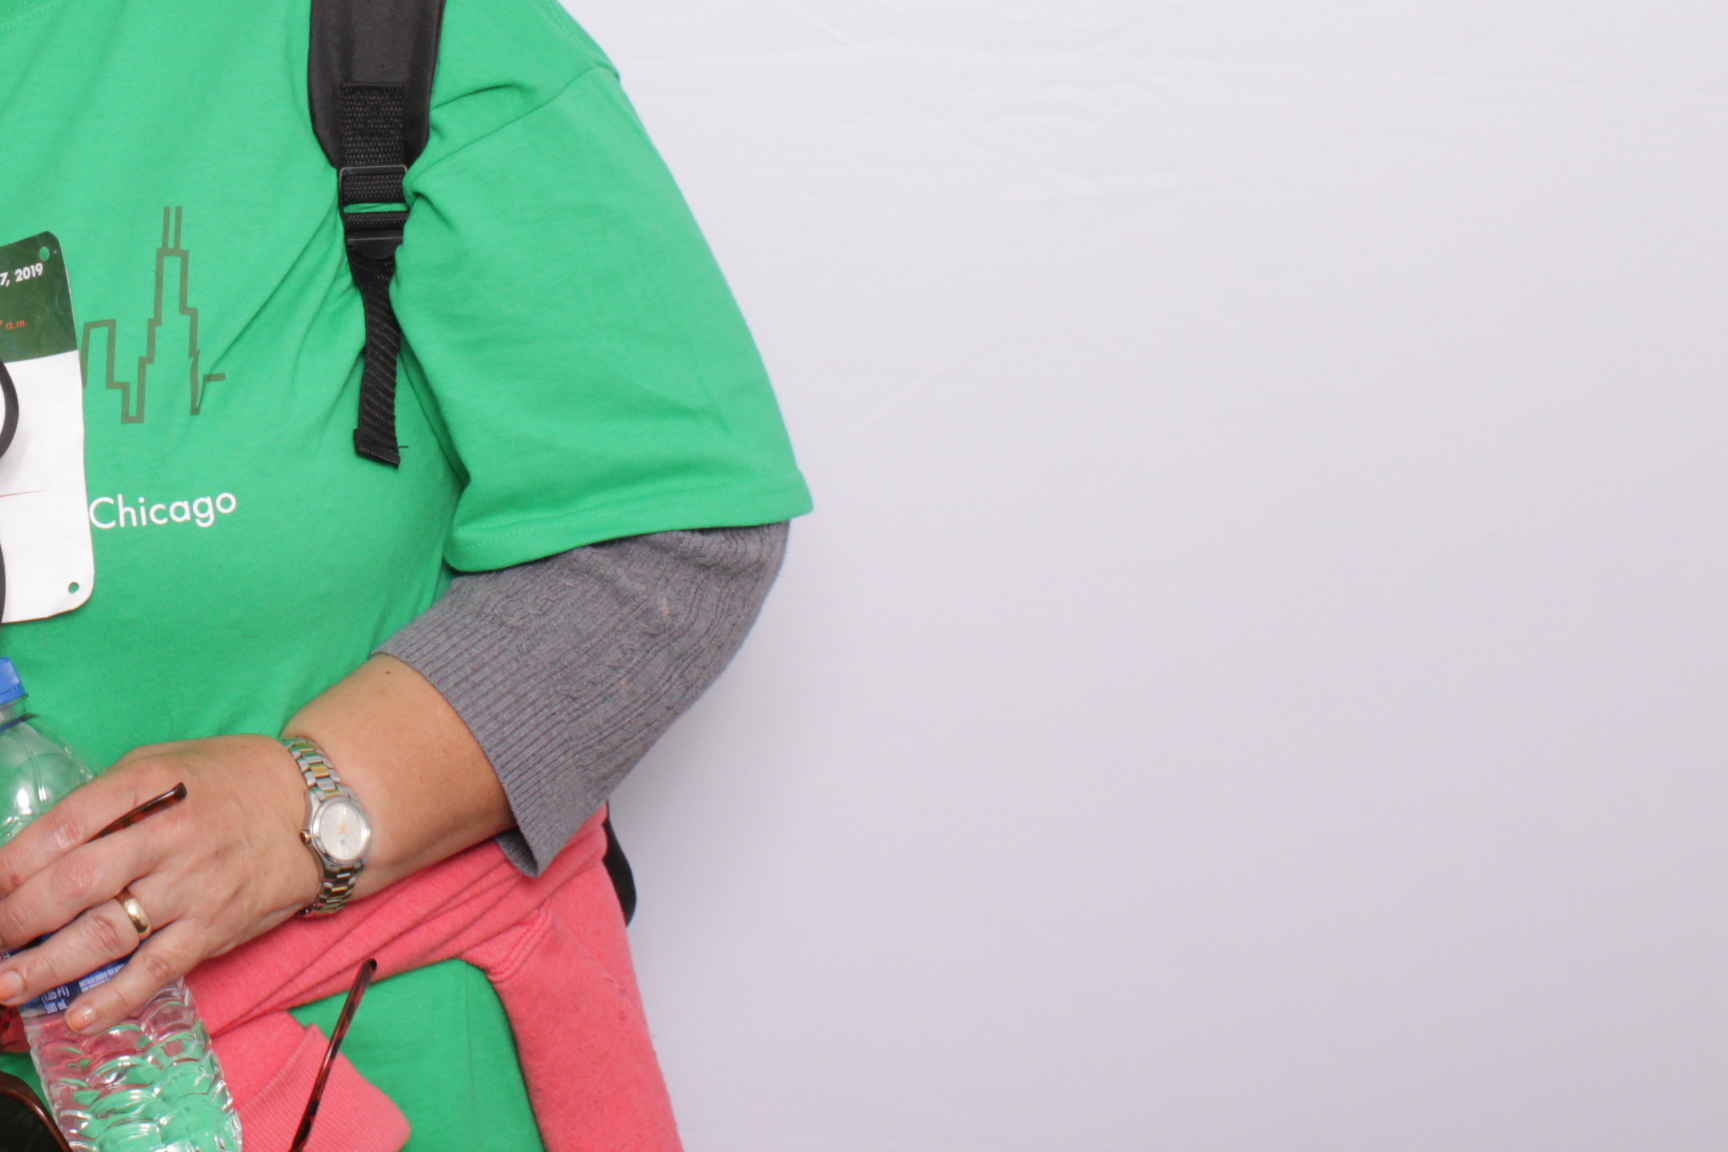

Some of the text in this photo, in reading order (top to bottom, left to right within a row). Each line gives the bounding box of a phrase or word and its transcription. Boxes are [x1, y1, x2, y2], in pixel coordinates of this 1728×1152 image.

[0, 272, 10, 287] 7,
[15, 263, 44, 283] 2019
[6, 319, 27, 330] a.m.
[88, 492, 238, 530] Chicago
